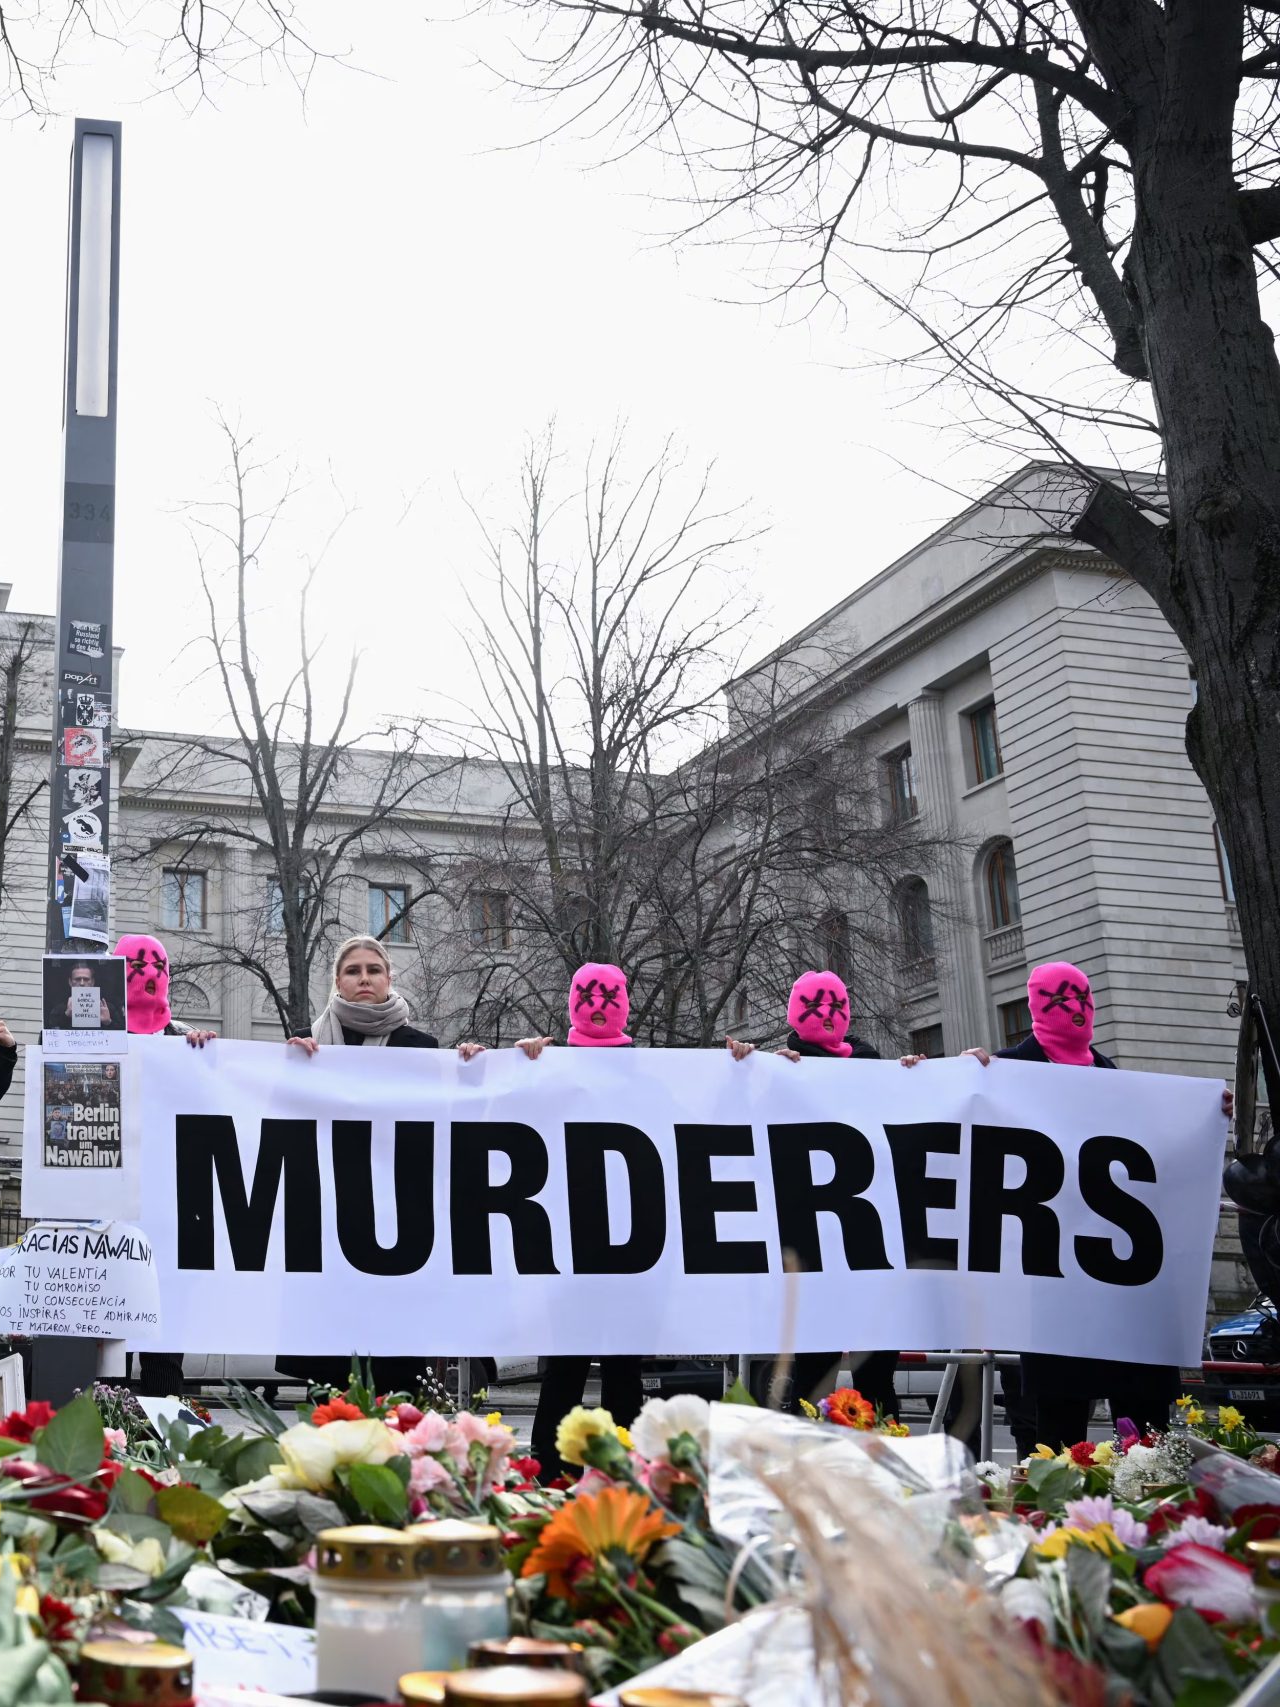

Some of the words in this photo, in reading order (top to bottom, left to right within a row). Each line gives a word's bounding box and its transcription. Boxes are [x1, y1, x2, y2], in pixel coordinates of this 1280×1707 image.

[68, 501, 111, 523] 334
[45, 1030, 58, 1038] НЕ
[48, 1040, 59, 1048] НЕ
[73, 1103, 119, 1123] Berlin
[66, 1122, 120, 1141] trauert
[79, 1141, 92, 1150] um
[45, 1145, 120, 1169] Nawalny
[175, 1114, 1164, 1287] MURDERERS
[24, 1265, 41, 1279] TU
[24, 1280, 40, 1291] TU
[24, 1293, 39, 1305] TU
[44, 1295, 126, 1307] CONSECUENCIA
[19, 1304, 67, 1320] INSPIRAS
[83, 1309, 96, 1320] TE
[104, 1310, 158, 1324] ADMIRAMOS
[9, 1321, 23, 1331] TE
